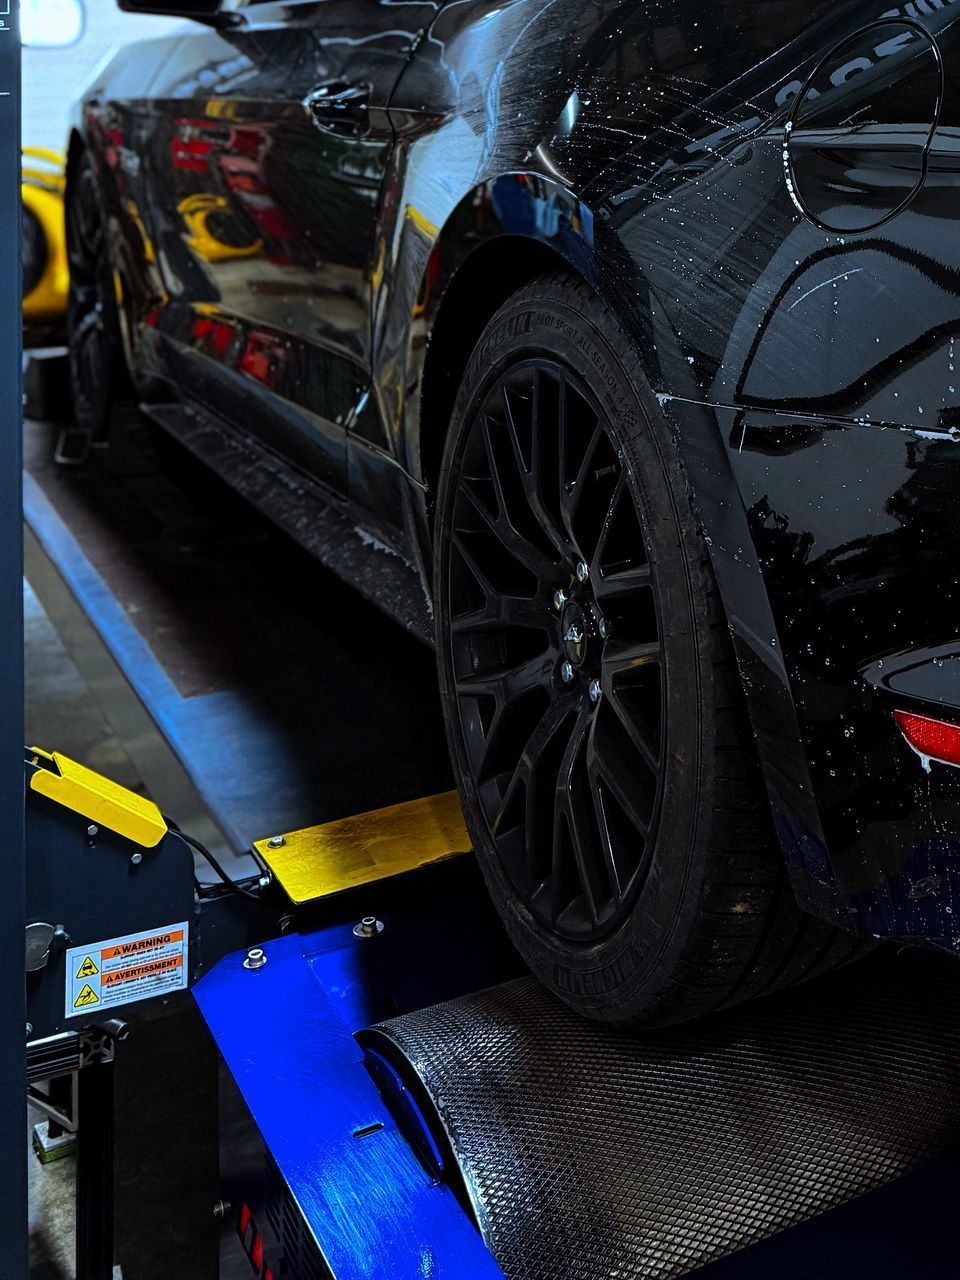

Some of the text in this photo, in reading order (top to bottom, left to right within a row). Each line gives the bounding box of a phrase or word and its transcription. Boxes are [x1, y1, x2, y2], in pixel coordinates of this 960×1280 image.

[555, 319, 578, 340] SPORT
[577, 336, 594, 352] ALL
[591, 352, 619, 394] SEASON
[122, 935, 171, 953] WARNING
[114, 958, 178, 981] AVERTISSMENT
